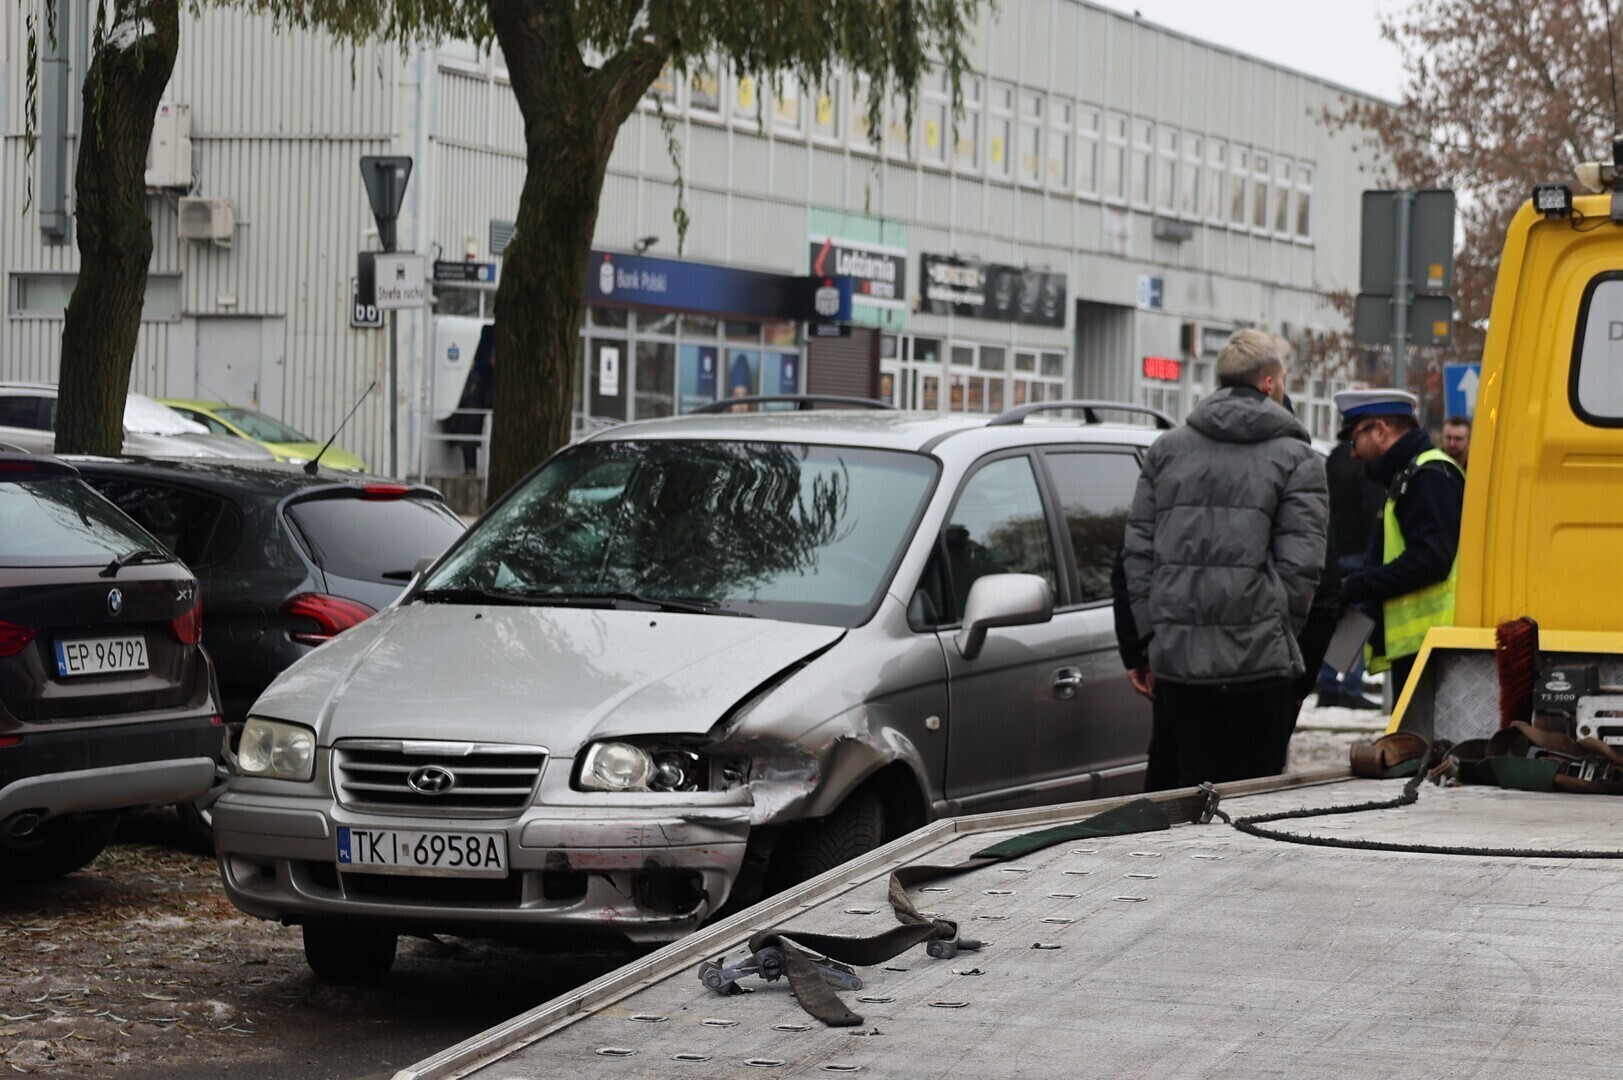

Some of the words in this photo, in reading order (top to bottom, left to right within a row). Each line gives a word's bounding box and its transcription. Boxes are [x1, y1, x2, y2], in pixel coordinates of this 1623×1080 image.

[836, 247, 896, 282] Lodziarnia
[617, 267, 639, 290] Bank
[378, 286, 401, 301] Strefa
[404, 285, 424, 300] ruchu
[176, 589, 193, 601] X1
[66, 643, 89, 672] EP
[96, 640, 146, 670] 96792
[1541, 693, 1552, 701] TS
[340, 849, 350, 859] PL
[352, 830, 398, 864] TKI
[413, 833, 501, 868] 6958A
